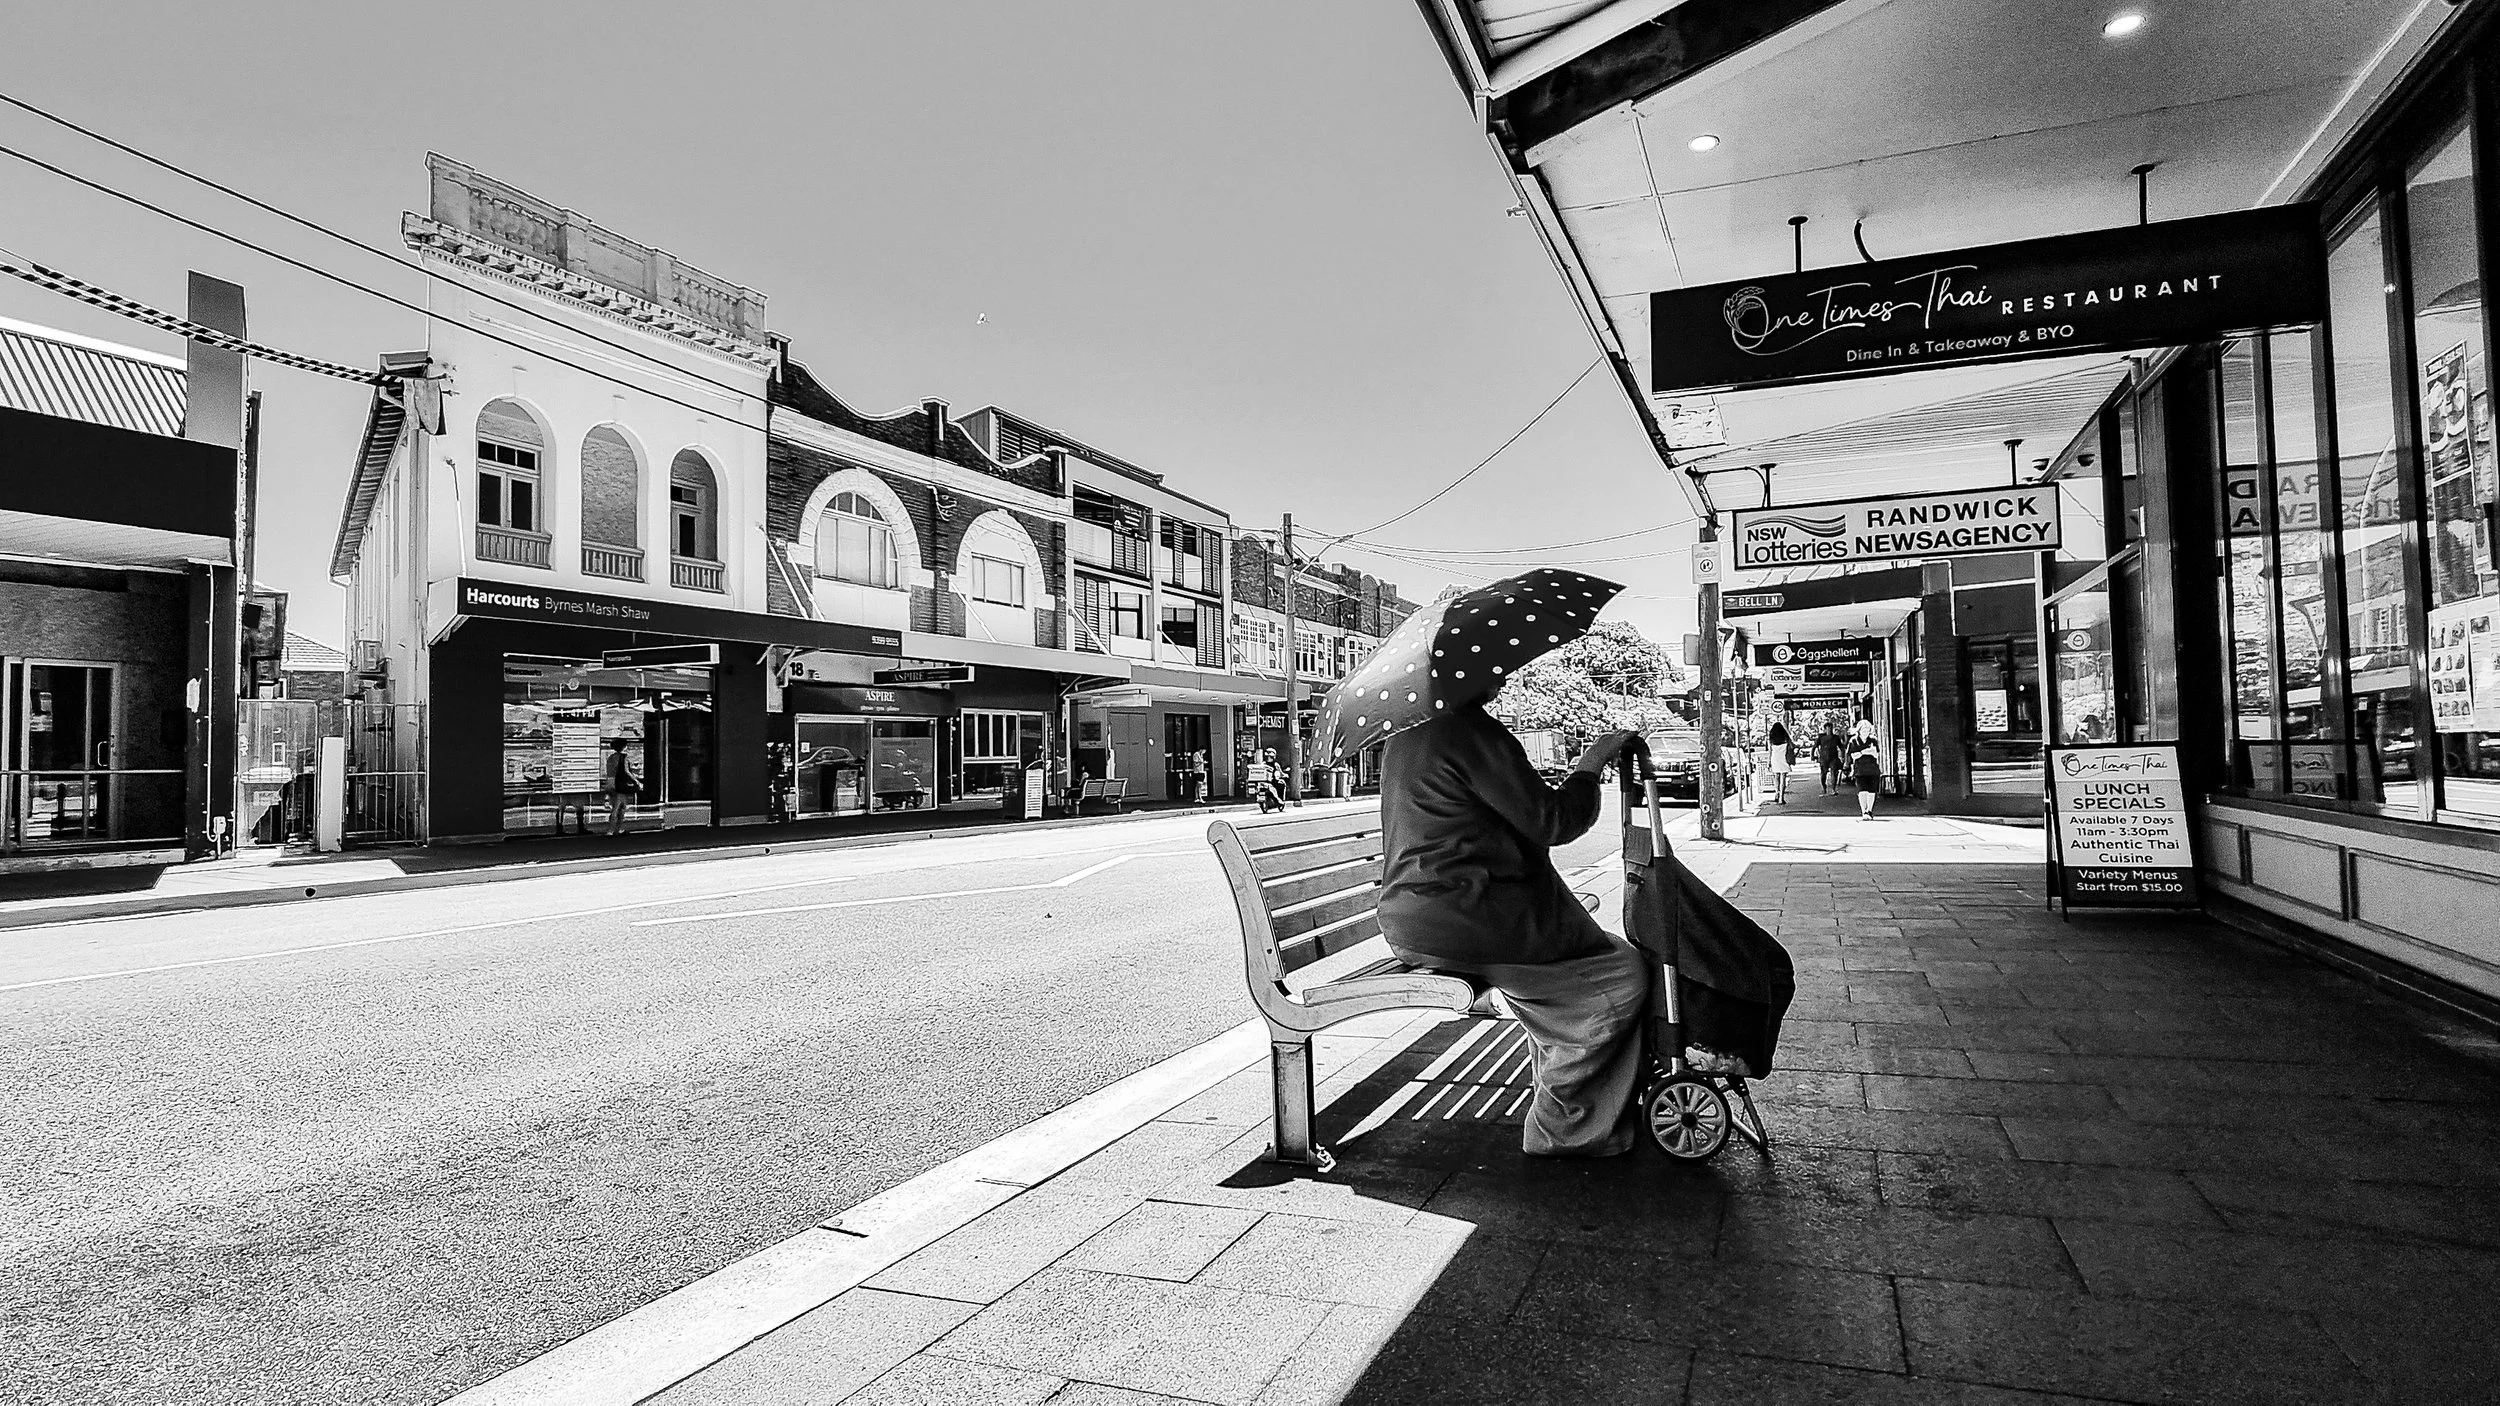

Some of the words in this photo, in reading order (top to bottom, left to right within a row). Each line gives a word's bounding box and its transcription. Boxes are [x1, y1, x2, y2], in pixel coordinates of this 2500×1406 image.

[2001, 274, 2222, 316] RESTAURANT
[1734, 293, 1814, 350] One
[1807, 282, 1918, 330] Times
[1895, 265, 1993, 330] Thai
[1846, 349, 1883, 362] Dine
[1888, 346, 1902, 357] In
[1908, 343, 1920, 354] &
[1925, 335, 2013, 353] Takeaway
[2018, 330, 2030, 343] &
[2037, 324, 2074, 341] BYO
[1867, 495, 2039, 529] RANDWICK
[1746, 526, 1788, 541] NSW
[1855, 521, 2052, 555] NEWSAGENCY
[1744, 538, 1848, 565] Lotteries
[466, 587, 540, 609] Harcourts
[545, 596, 584, 614] Byrnes
[586, 602, 619, 617] Marsh
[621, 605, 650, 621] Shaw
[1738, 596, 1762, 607] BELL
[1765, 595, 1778, 606] LN
[790, 661, 804, 677] 18
[892, 671, 925, 681] ASPIRE
[865, 690, 896, 702] ASPIRE
[1802, 700, 1843, 708] MONARCH
[2130, 752, 2168, 775] Thai
[2084, 783, 2151, 796] LUNCH
[2073, 797, 2166, 810] SPECIALS
[2069, 815, 2127, 825] Available
[2130, 816, 2138, 825] 7
[2142, 815, 2175, 826] Days
[2077, 827, 2106, 837] 11am
[2119, 827, 2169, 838] 3:30pm
[2070, 839, 2143, 850] Authentic
[2147, 839, 2180, 850] Thai
[2098, 853, 2154, 863] Cuisine
[2078, 869, 2128, 881] Variety
[2132, 870, 2178, 880] Menus
[2076, 882, 2106, 891] Start
[2109, 882, 2138, 892] from
[2141, 882, 2183, 892] $15.00
